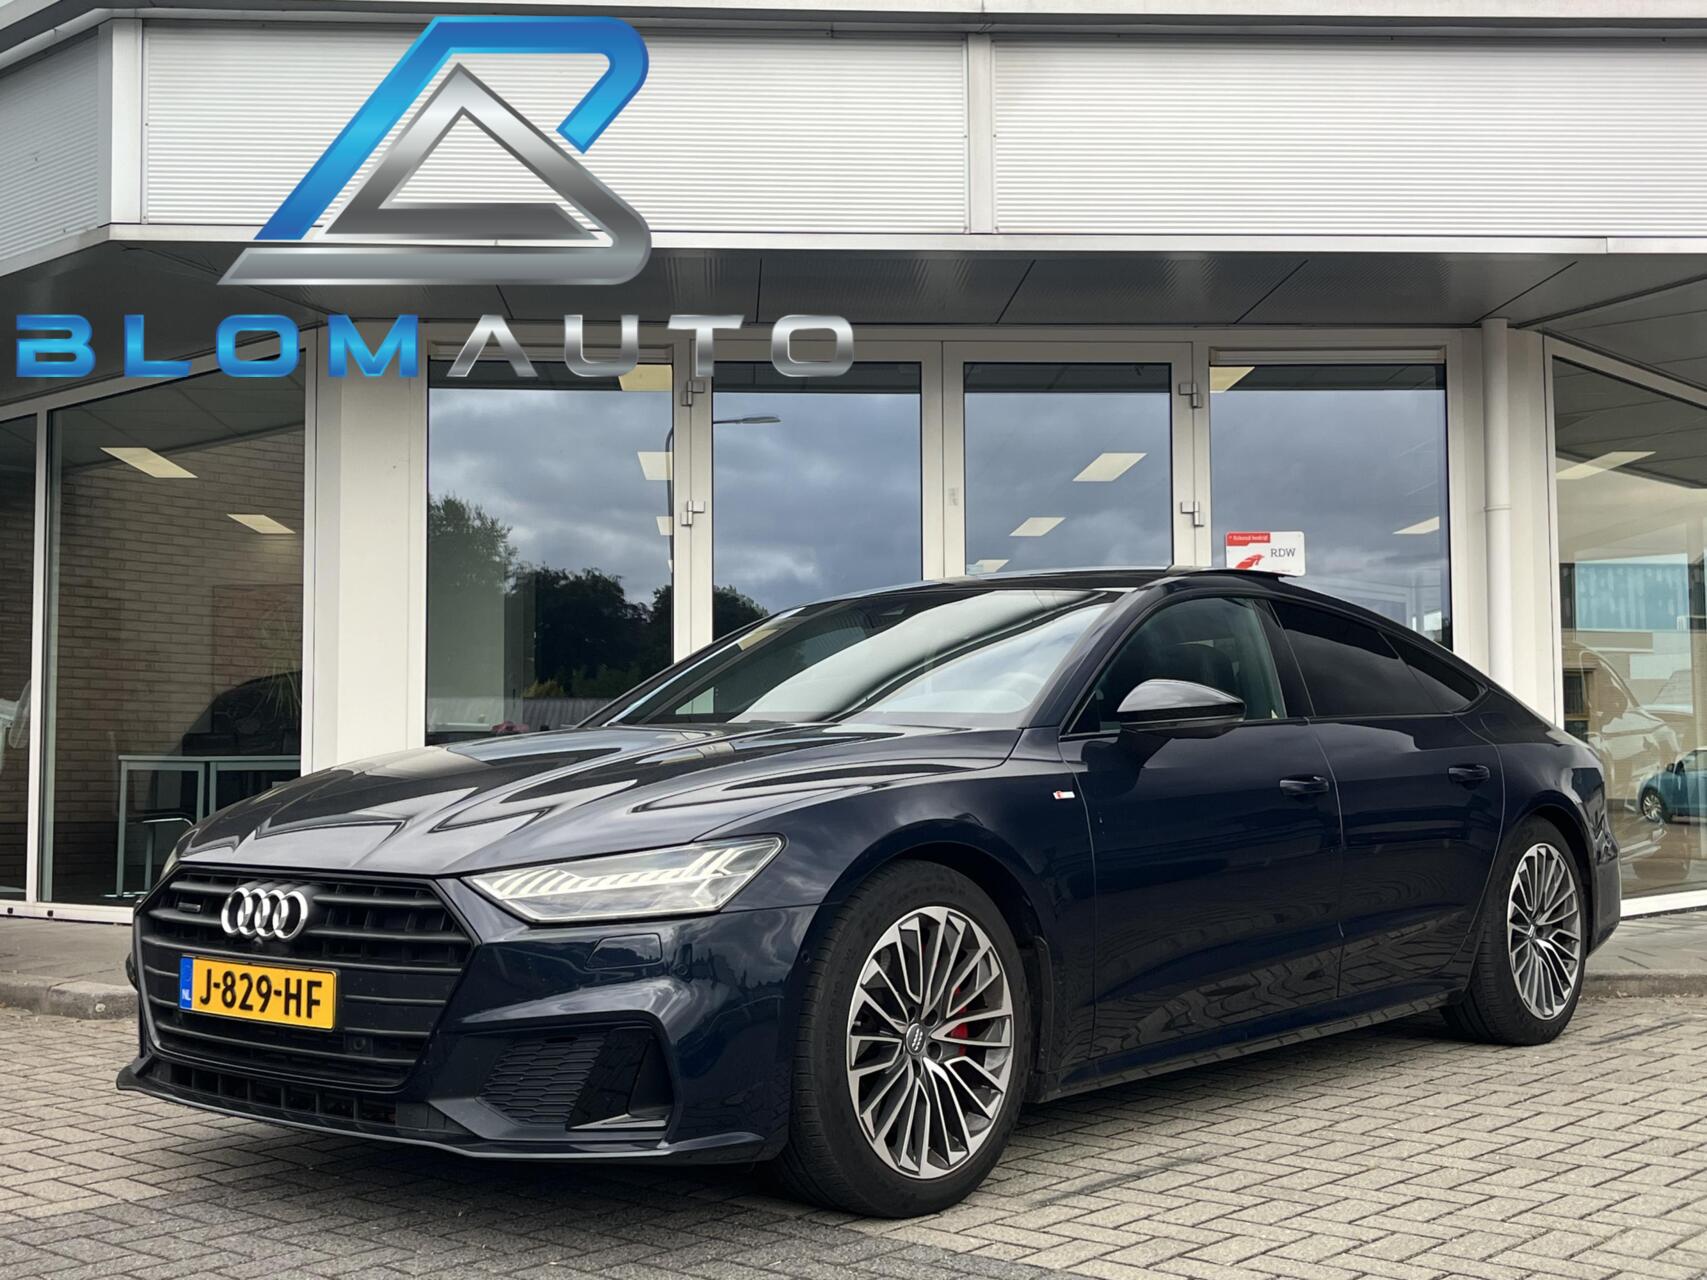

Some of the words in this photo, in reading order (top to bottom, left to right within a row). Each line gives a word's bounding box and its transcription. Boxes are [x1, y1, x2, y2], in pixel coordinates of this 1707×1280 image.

[1270, 548, 1296, 558] RDW
[181, 989, 192, 1001] NL
[200, 968, 323, 1019] J-829-HF
